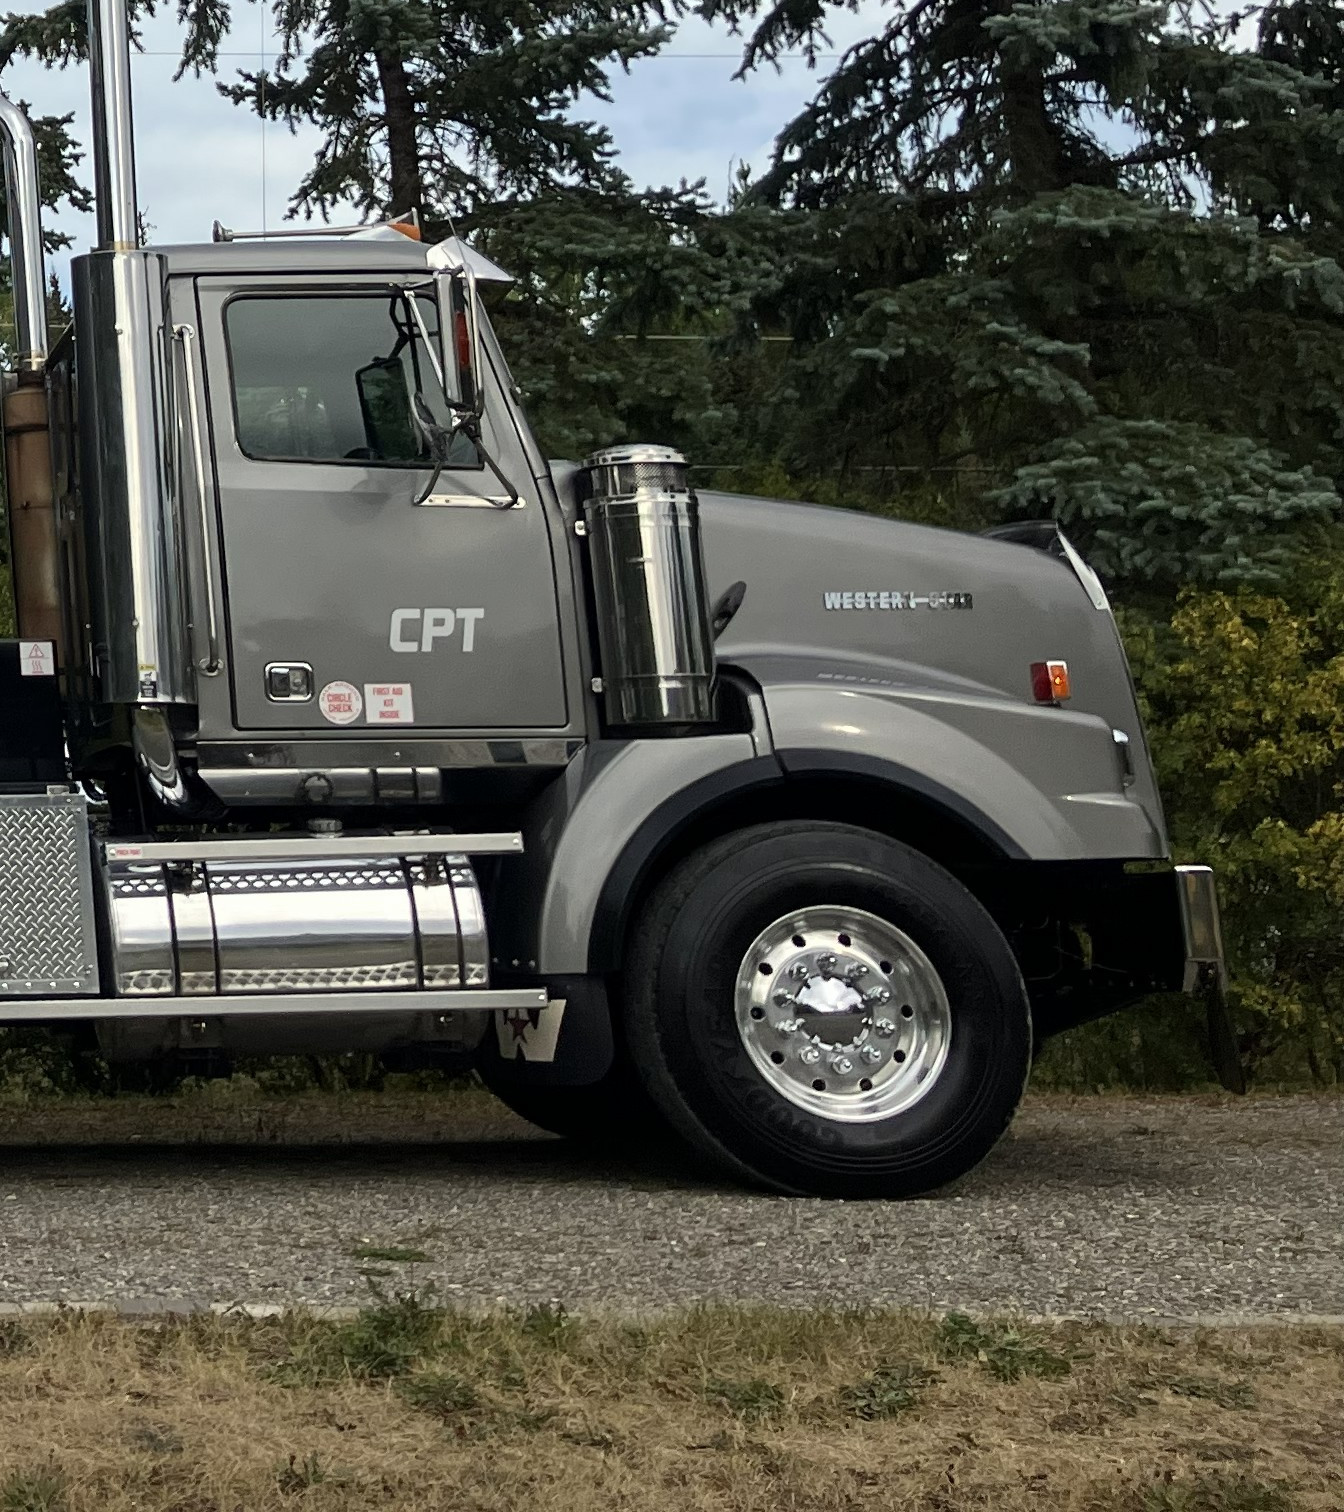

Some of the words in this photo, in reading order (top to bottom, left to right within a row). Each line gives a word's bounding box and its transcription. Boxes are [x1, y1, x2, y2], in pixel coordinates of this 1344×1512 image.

[824, 591, 917, 609] WESTERN
[390, 608, 484, 653] CPT
[373, 687, 390, 696] FIRST
[392, 687, 403, 696] AID
[327, 693, 352, 702] CIRCLE
[384, 699, 393, 707] KIT
[328, 704, 353, 713] CHECK
[379, 710, 399, 719] INSIDE
